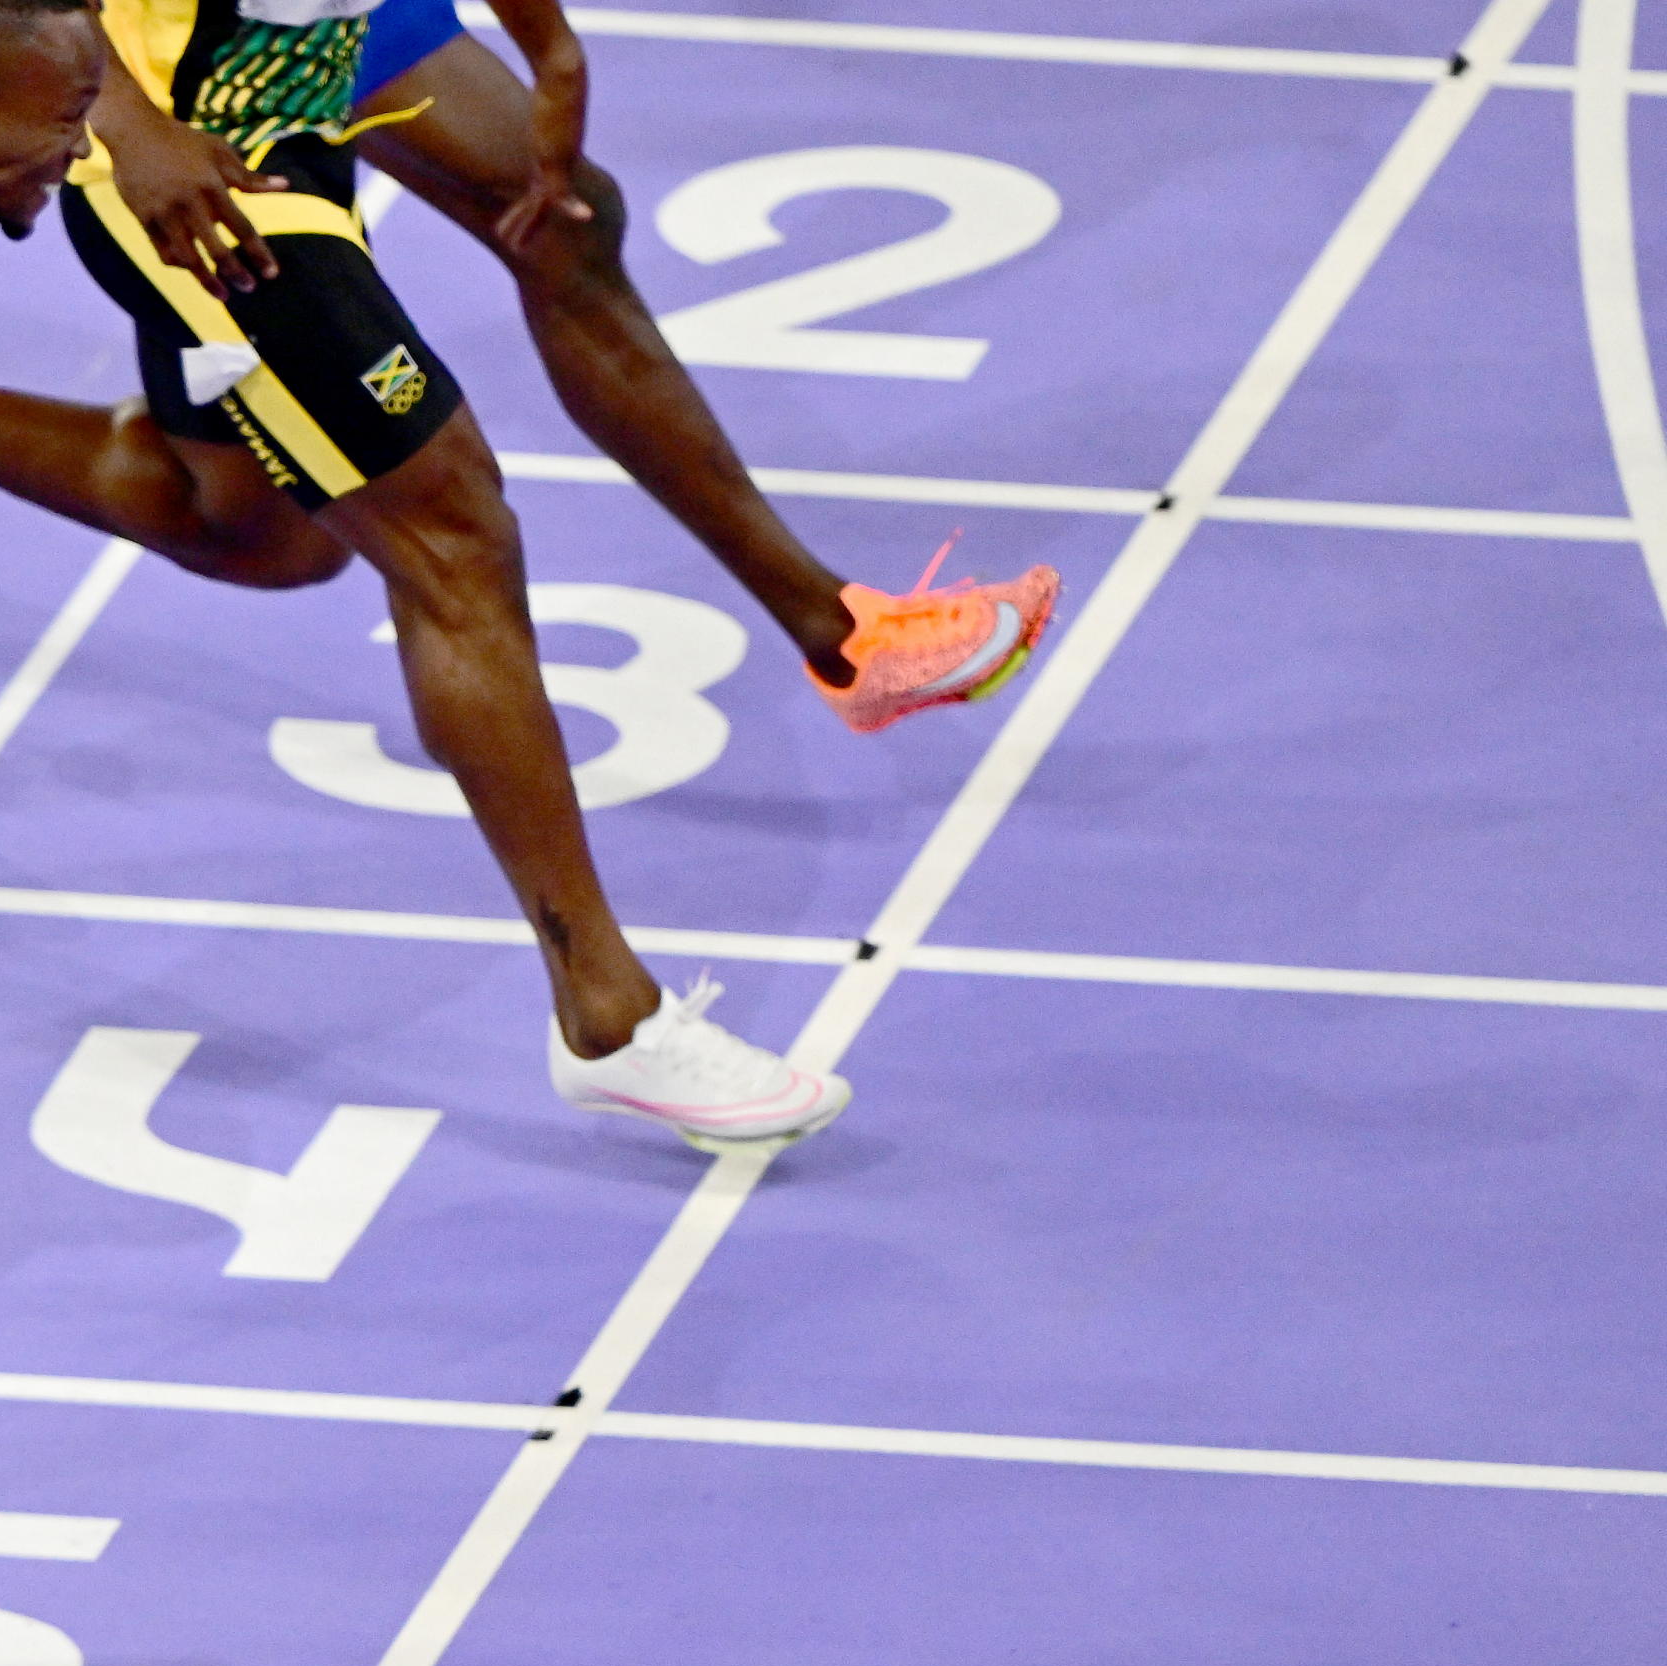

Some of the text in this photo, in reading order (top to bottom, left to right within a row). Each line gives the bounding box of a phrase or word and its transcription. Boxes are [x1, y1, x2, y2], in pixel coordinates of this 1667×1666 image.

[655, 146, 1062, 380] 2
[219, 396, 299, 488] JAMAIC
[270, 583, 750, 819] 3
[29, 1025, 444, 1283] 4
